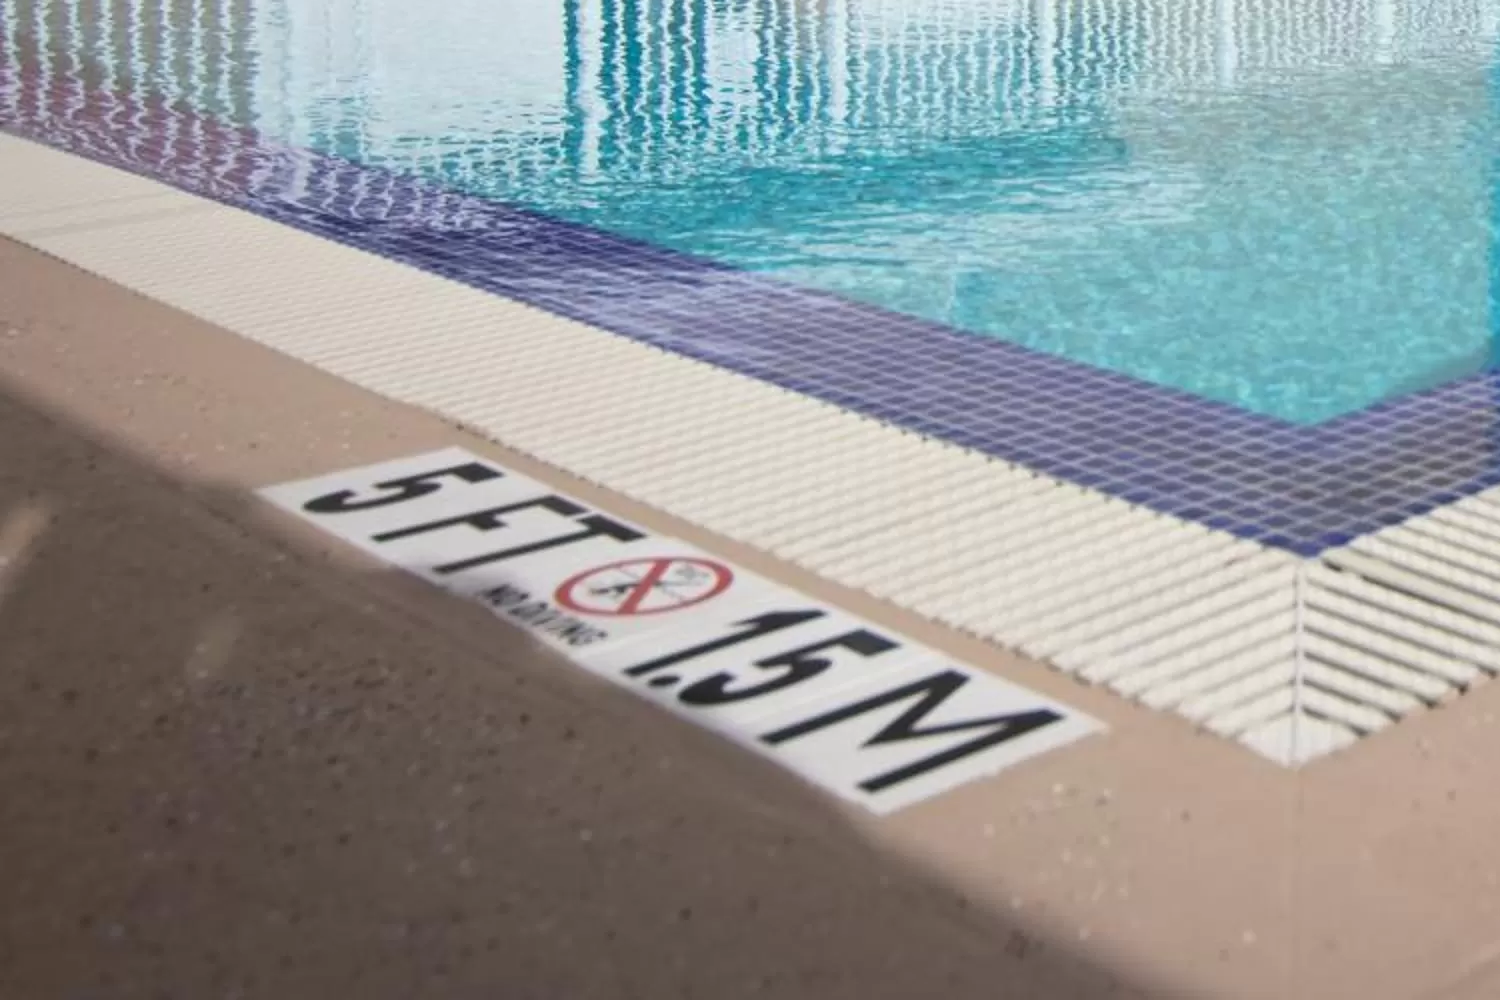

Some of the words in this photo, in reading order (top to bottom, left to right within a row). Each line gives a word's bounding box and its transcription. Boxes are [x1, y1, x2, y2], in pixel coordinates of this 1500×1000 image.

[302, 462, 506, 513] 5
[369, 494, 649, 575] FT
[480, 583, 531, 607] NO
[507, 602, 608, 646] DIVING
[622, 609, 903, 707] 1.5
[757, 668, 1069, 794] M
